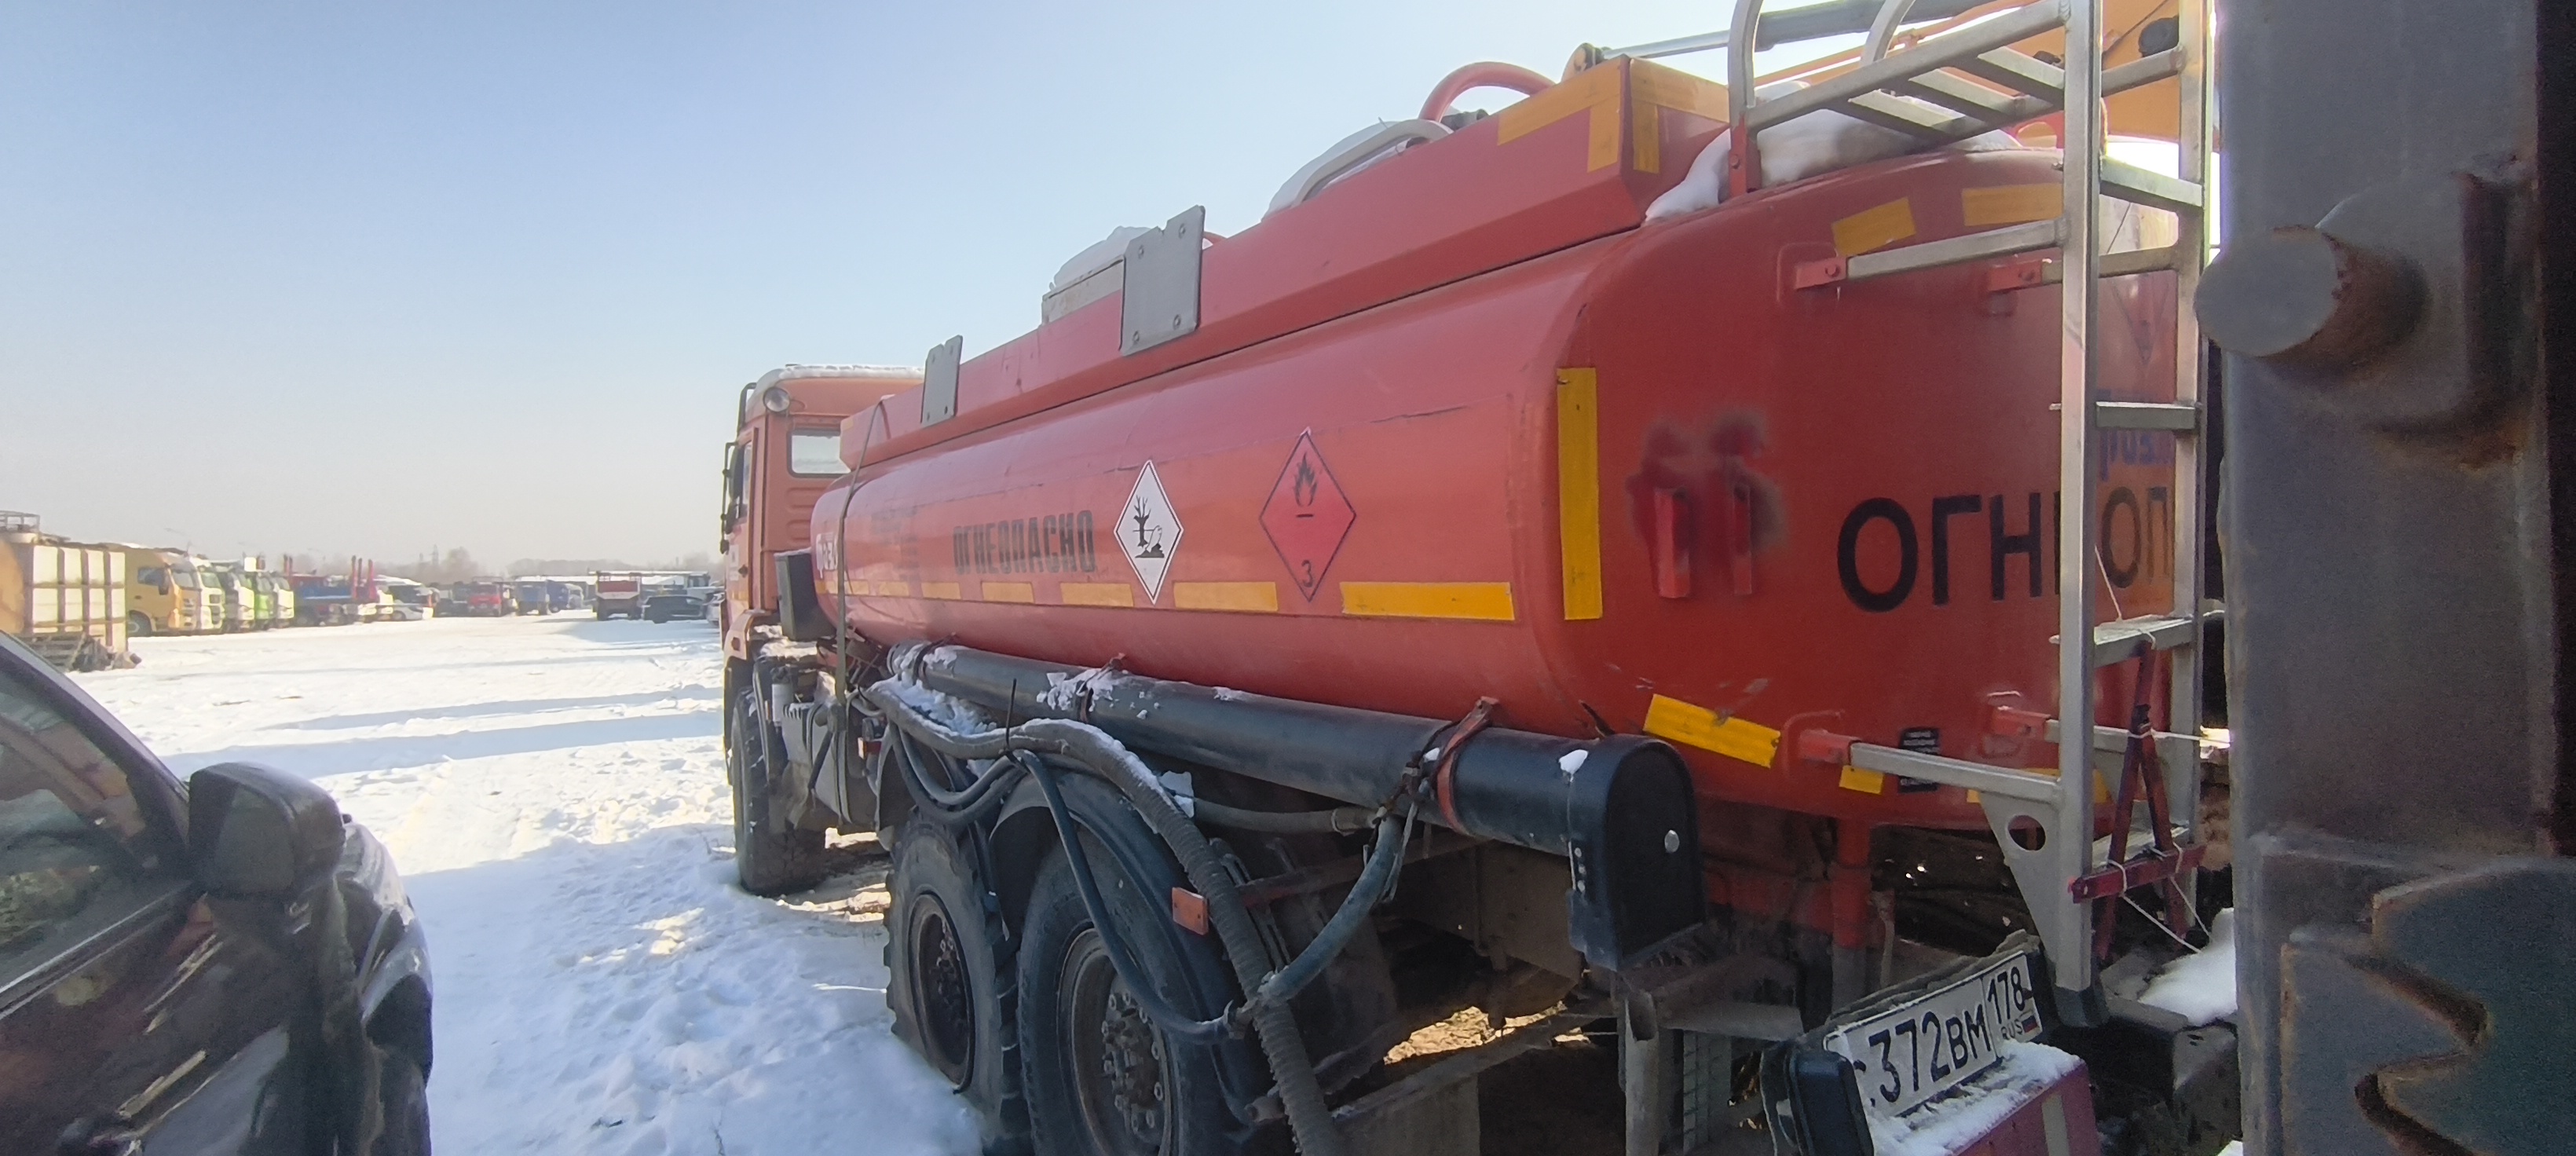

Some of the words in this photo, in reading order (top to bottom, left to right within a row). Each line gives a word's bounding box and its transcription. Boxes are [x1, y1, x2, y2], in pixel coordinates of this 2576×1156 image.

[953, 510, 1096, 575] ОГНЕОПАСНО
[1836, 486, 2170, 613] ОГНОП
[1301, 560, 1313, 587] 3
[1987, 966, 2025, 1024] 178
[2000, 1019, 2024, 1041] RUS
